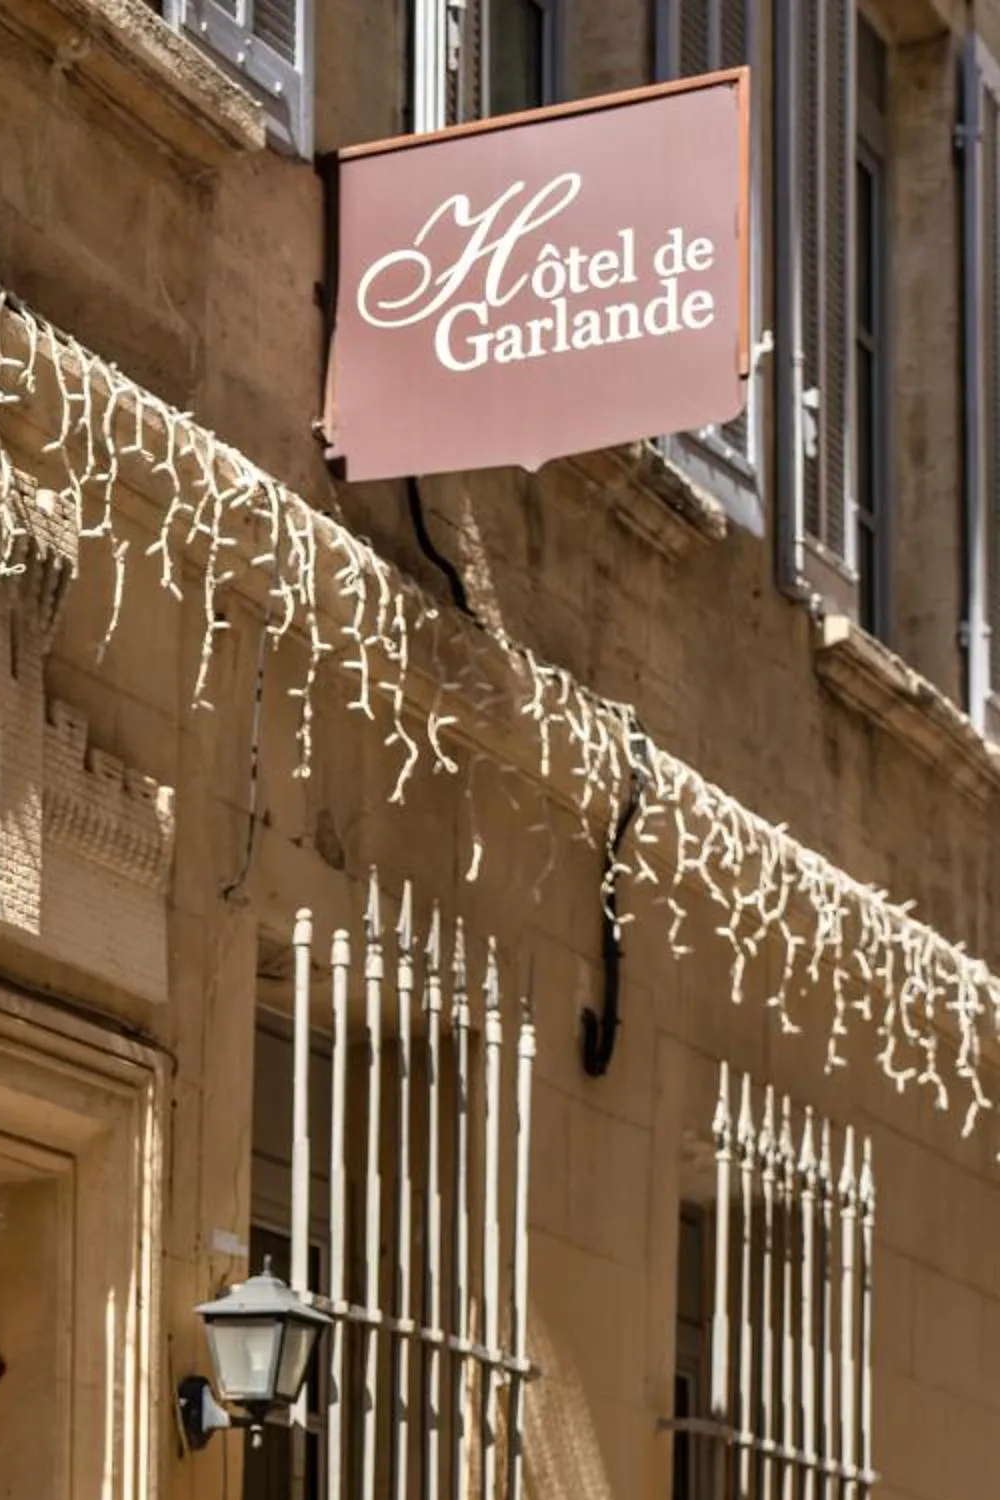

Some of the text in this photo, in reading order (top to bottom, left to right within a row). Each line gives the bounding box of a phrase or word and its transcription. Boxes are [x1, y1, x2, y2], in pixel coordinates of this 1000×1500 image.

[357, 172, 715, 329] Hôtel de
[434, 273, 716, 372] Garlande
